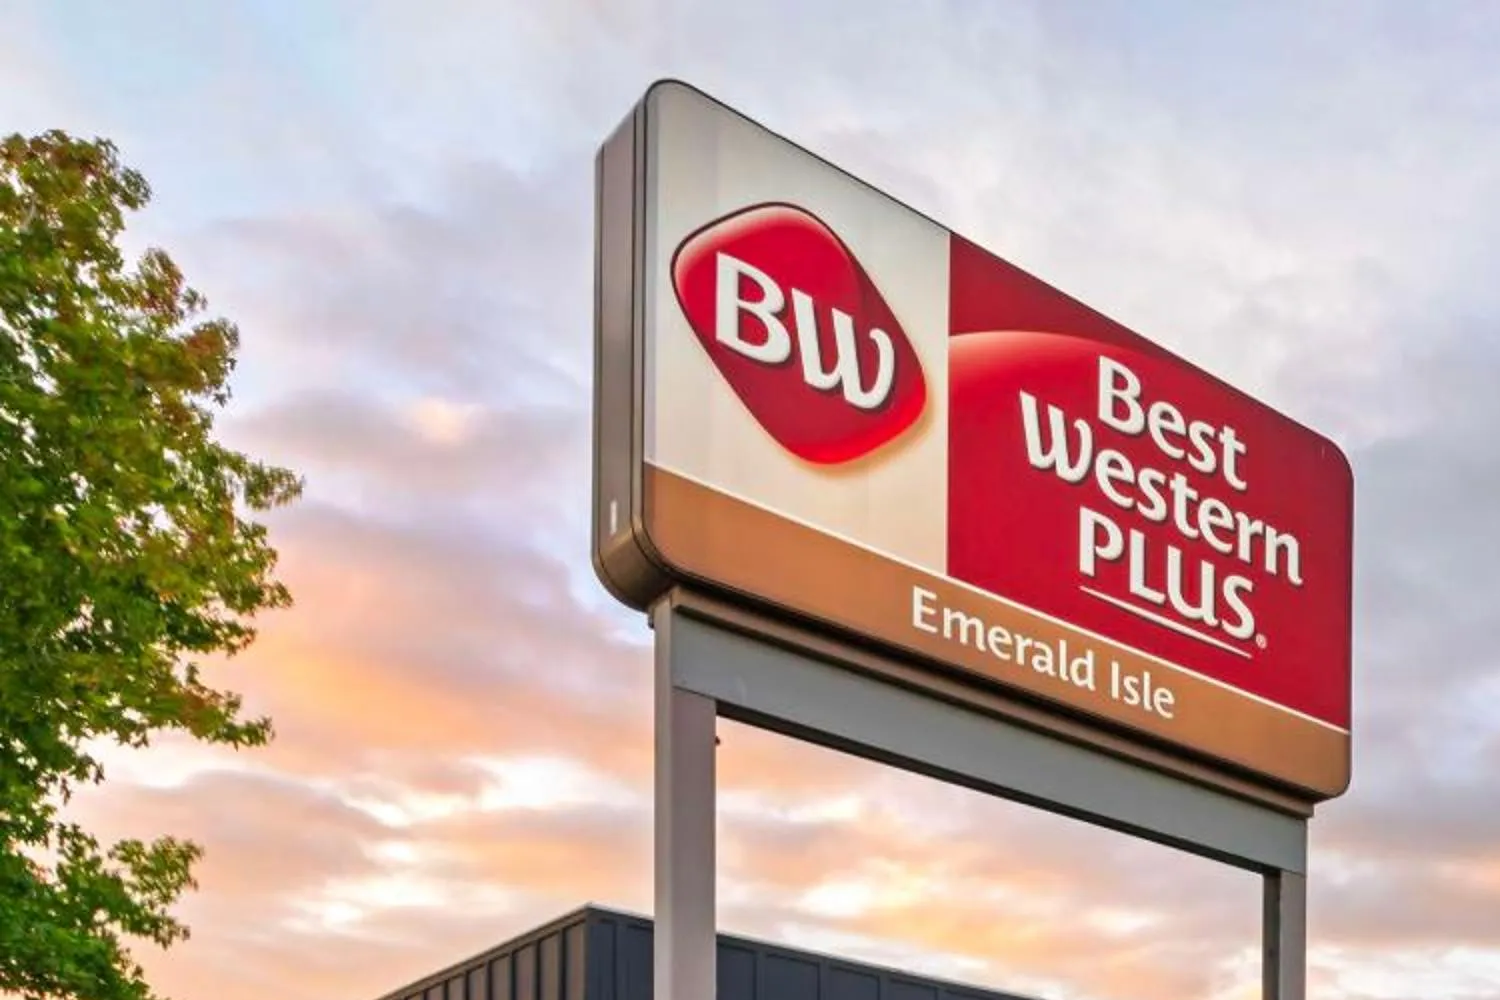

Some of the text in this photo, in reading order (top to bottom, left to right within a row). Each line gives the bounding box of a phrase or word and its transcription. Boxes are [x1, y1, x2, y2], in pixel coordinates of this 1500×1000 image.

[715, 251, 895, 411] BW
[1019, 390, 1303, 585] Western
[1098, 355, 1248, 490] Best
[912, 585, 1175, 718] Emerald Isle
